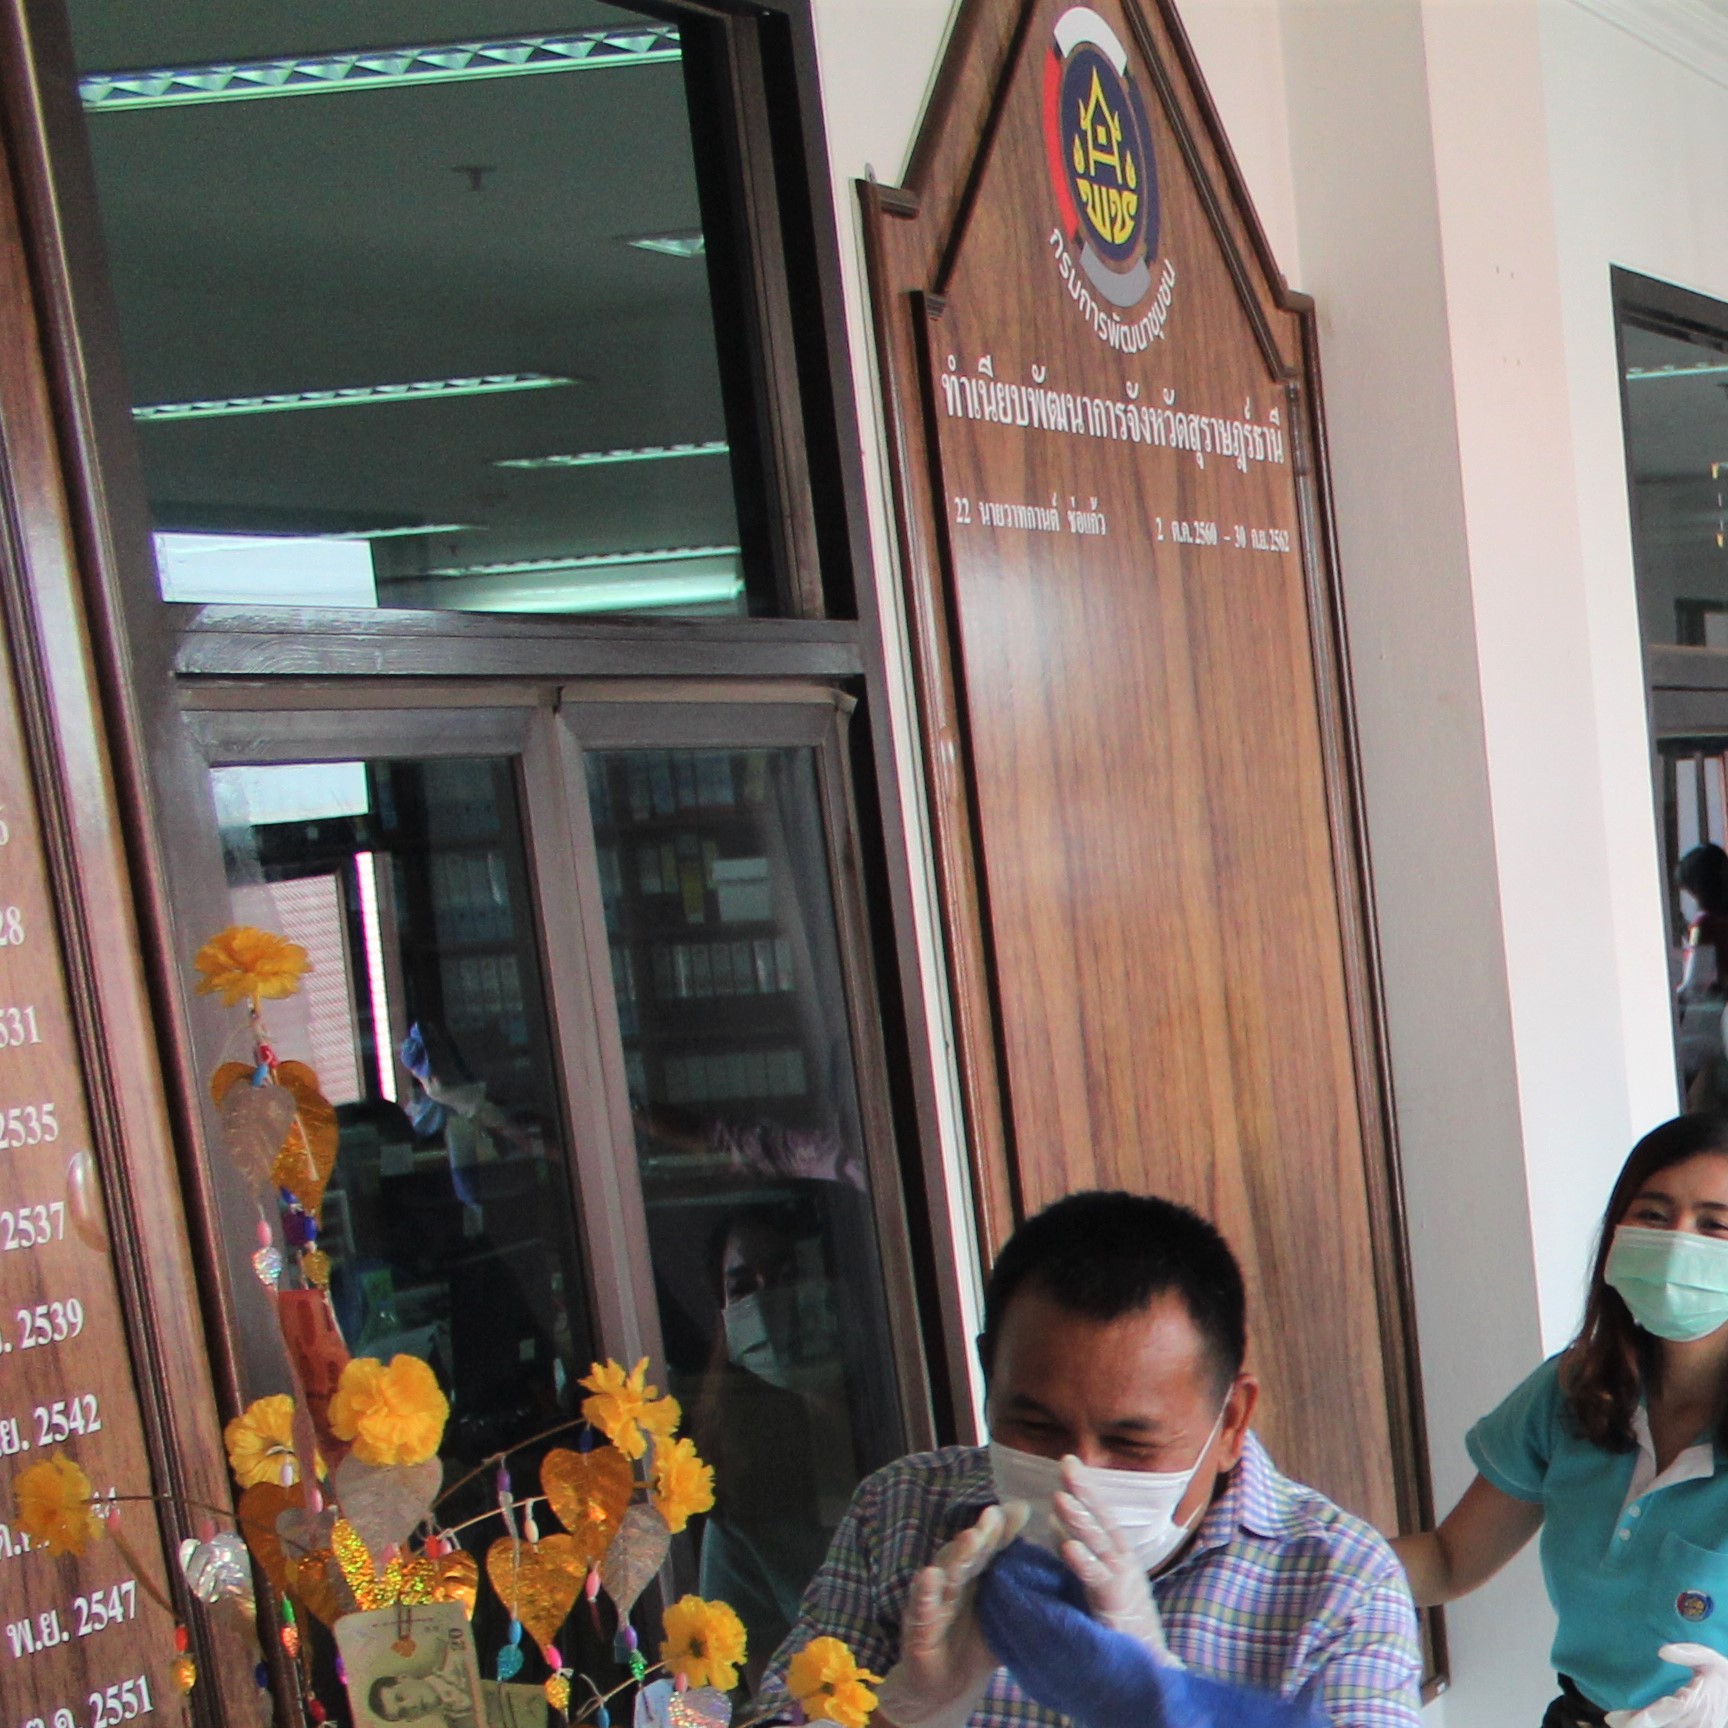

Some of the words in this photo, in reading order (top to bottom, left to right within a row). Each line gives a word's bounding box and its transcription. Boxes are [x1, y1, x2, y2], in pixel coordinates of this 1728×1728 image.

[1050, 228, 1176, 354] กรมการพัฒนาชุมชน
[941, 354, 1285, 474] ทำเนียบพัฒนาการจังหวัดสุราษฎร์ธานี
[954, 496, 972, 525] 22
[0, 1200, 65, 1252] 2537
[17, 1297, 85, 1350] 2539
[34, 1393, 103, 1448] 2542
[6, 1609, 71, 1659] พ.ย.
[73, 1580, 137, 1637] 2547
